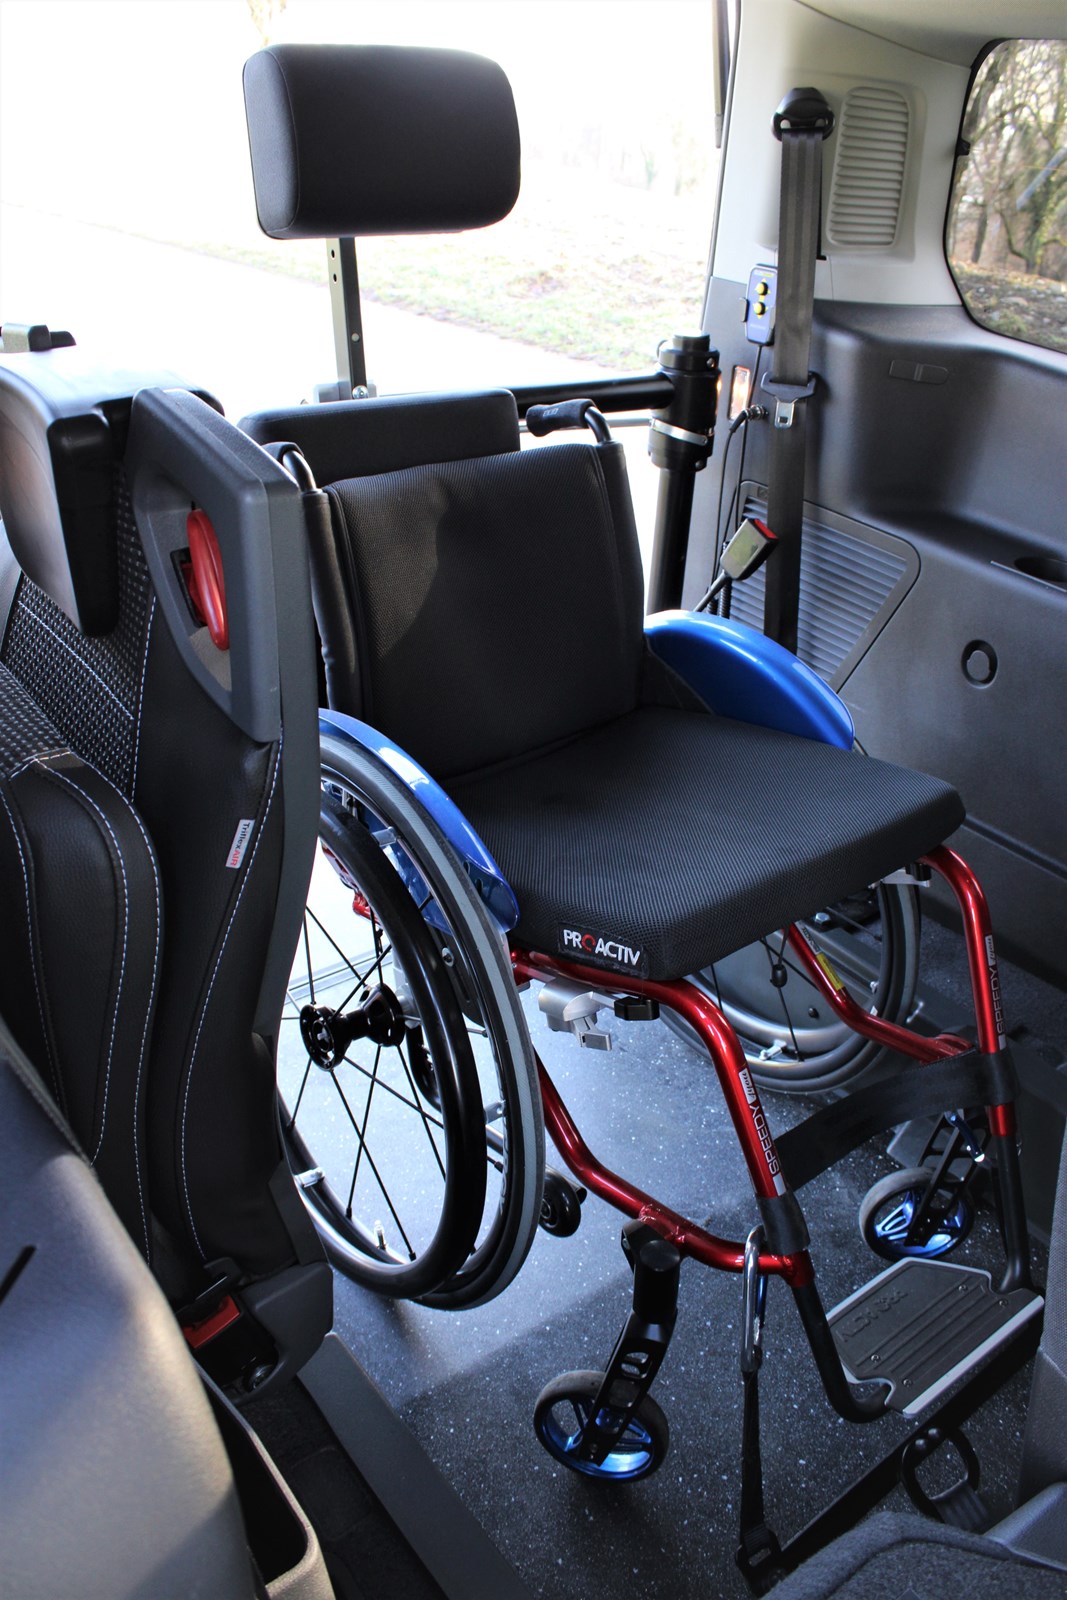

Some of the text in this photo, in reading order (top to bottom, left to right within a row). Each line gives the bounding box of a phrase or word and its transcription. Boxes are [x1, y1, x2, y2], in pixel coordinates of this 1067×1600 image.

[563, 929, 641, 966] PROACTIV
[989, 967, 1005, 1034] SPEEDY
[749, 1104, 780, 1175] SPEEDY
